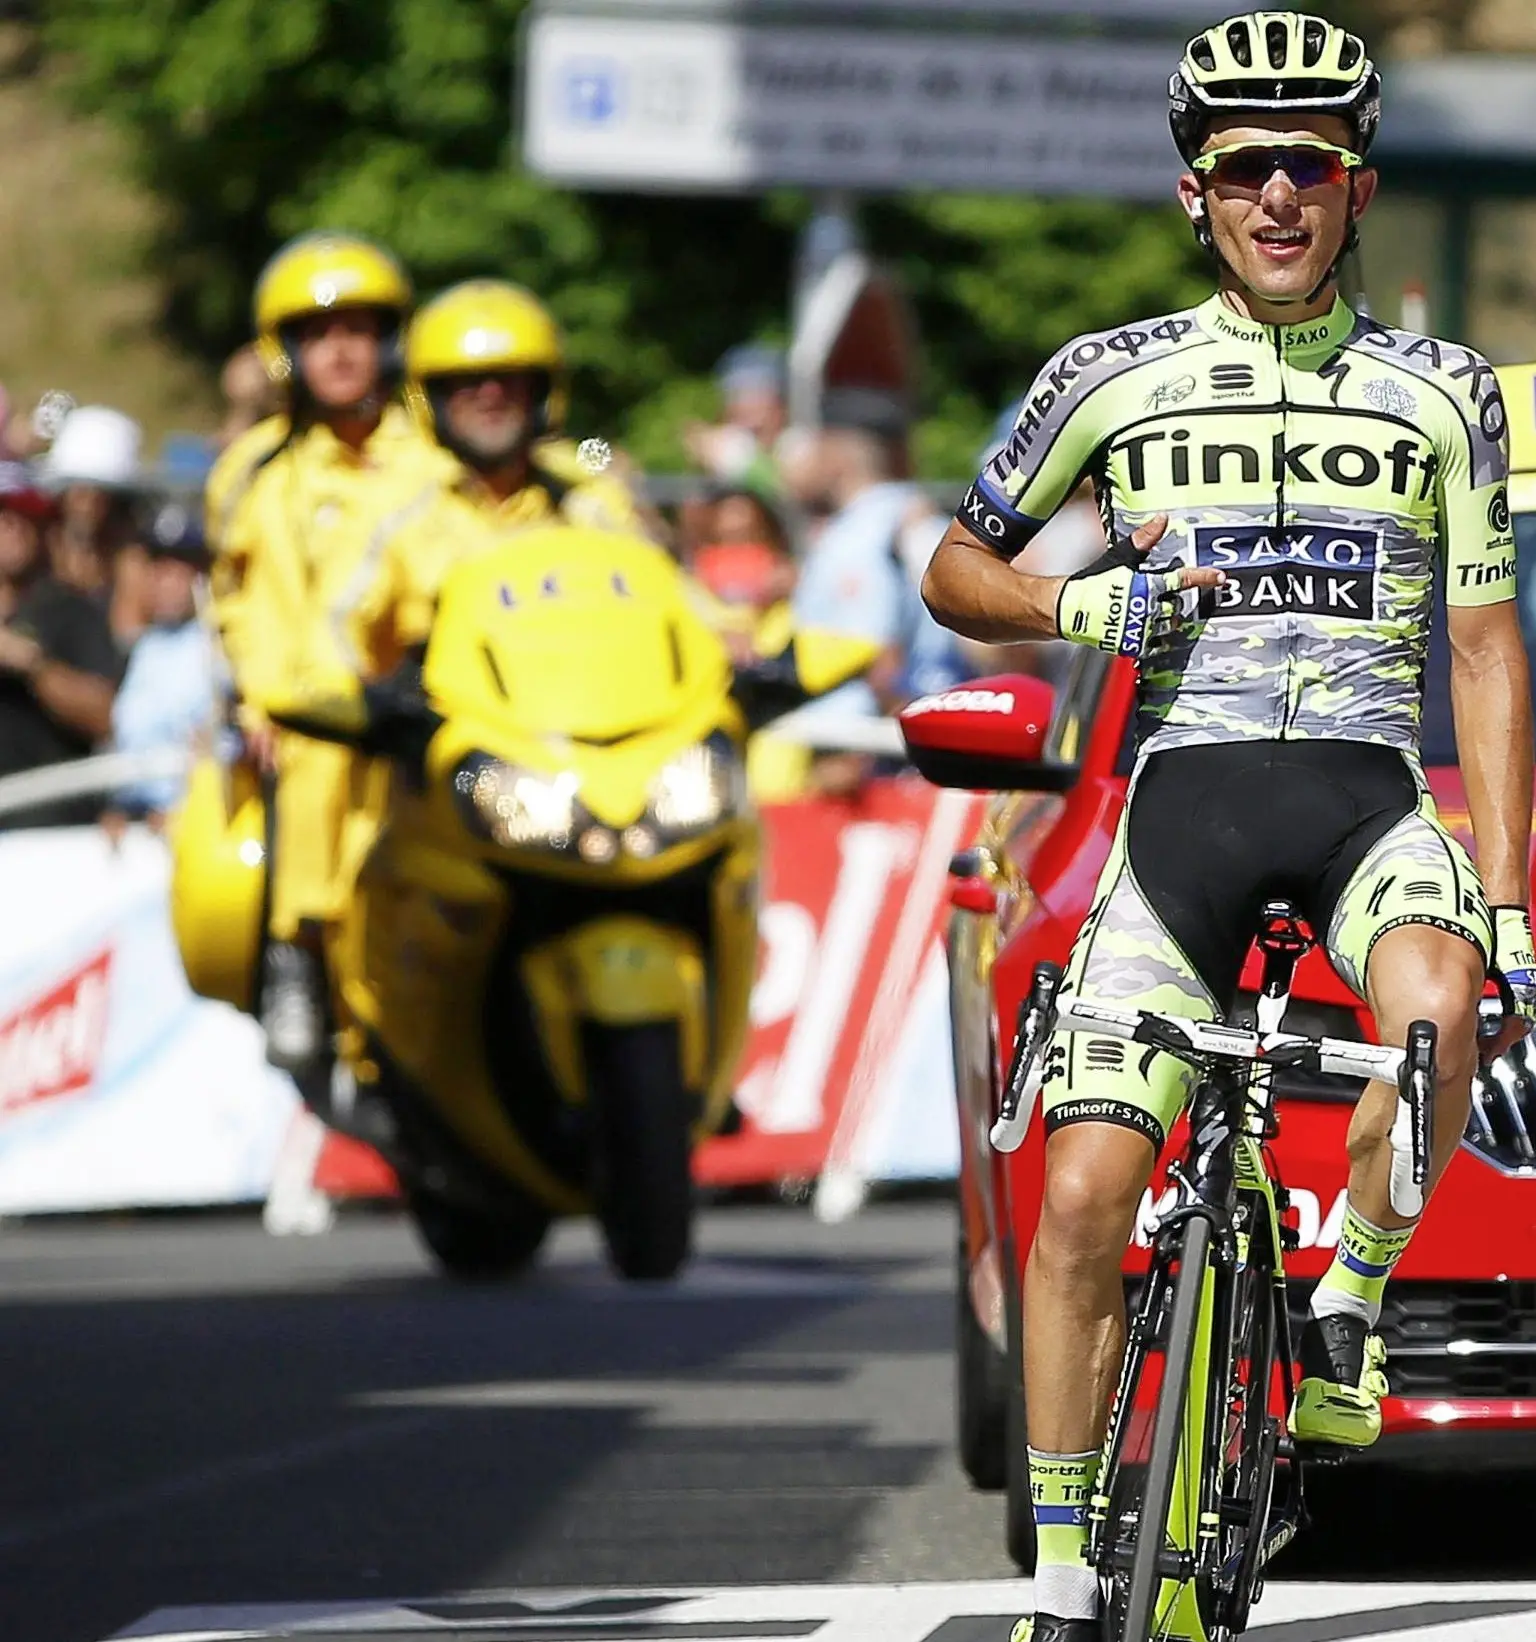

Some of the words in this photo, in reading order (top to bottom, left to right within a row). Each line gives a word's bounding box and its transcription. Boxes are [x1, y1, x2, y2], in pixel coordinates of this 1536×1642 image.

[1213, 314, 1264, 343] Tinkoff
[1285, 326, 1328, 345] SAXO
[1111, 429, 1437, 501] Tinkoff
[1210, 533, 1364, 567] SAXO
[1213, 573, 1360, 610] BANK
[1122, 596, 1146, 652] SAXO
[1054, 1102, 1163, 1140] Tinkoff-SAXO
